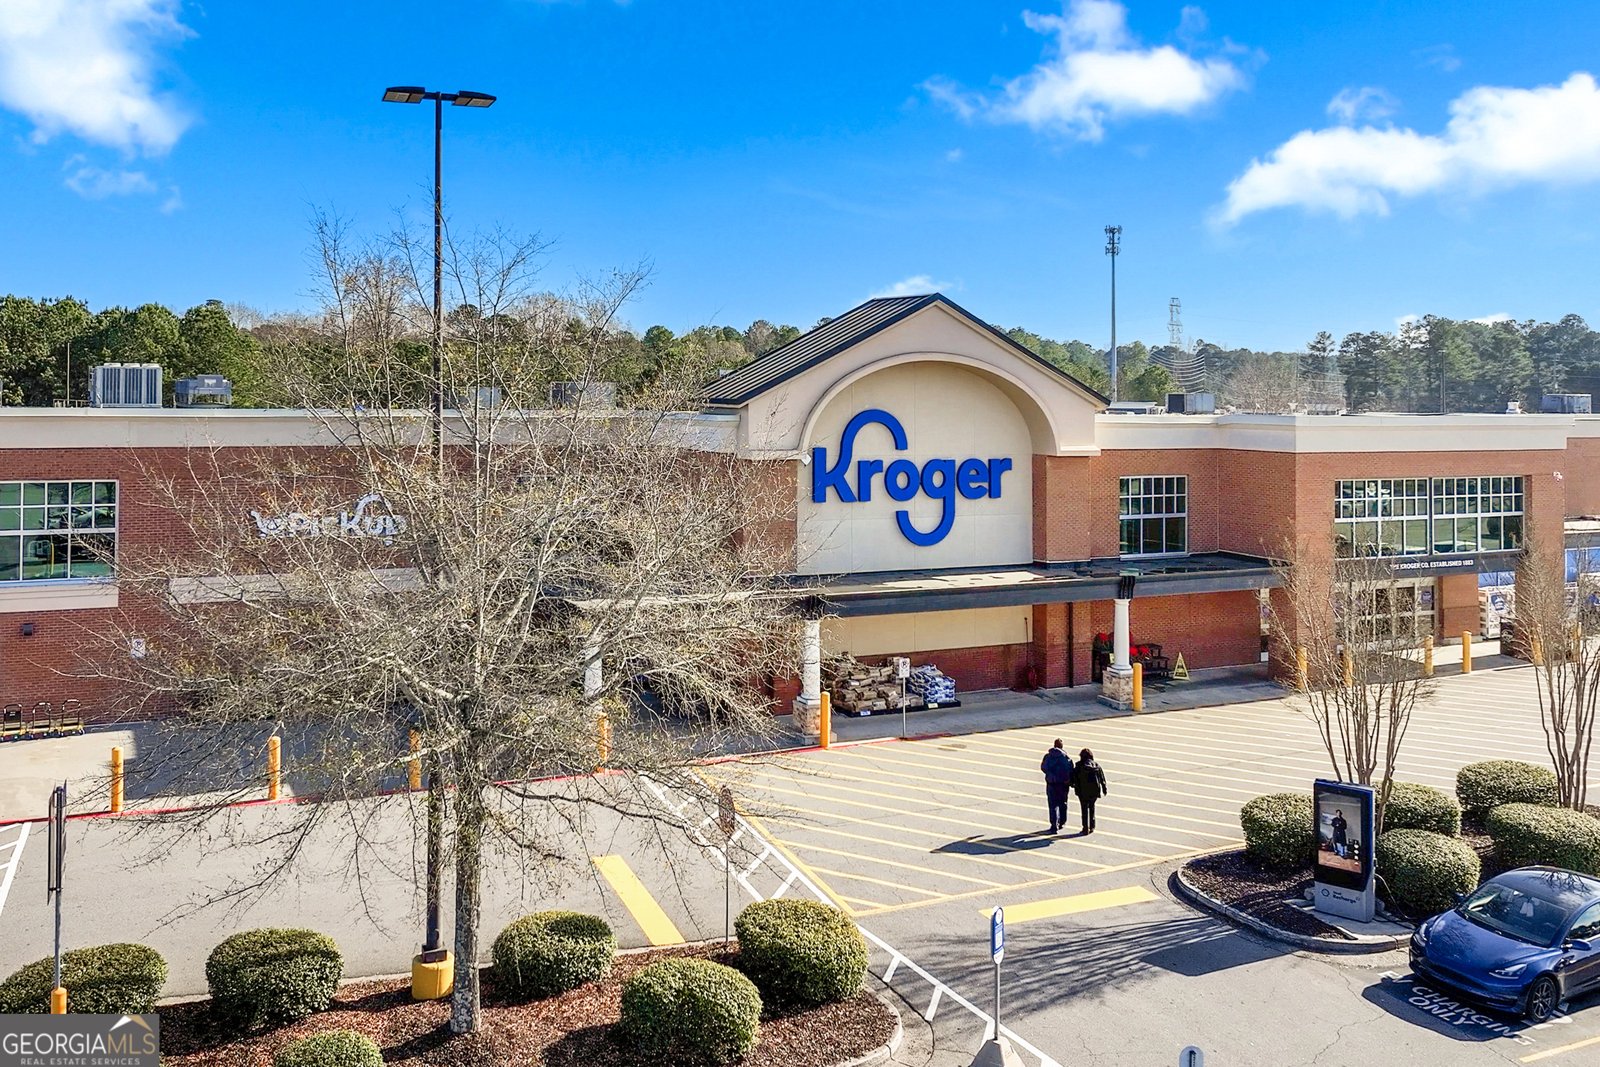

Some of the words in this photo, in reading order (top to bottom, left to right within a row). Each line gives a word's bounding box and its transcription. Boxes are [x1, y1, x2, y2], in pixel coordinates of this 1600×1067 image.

[812, 409, 1012, 546] Kroger
[1400, 562, 1420, 570] KROGER
[1430, 560, 1461, 568] ESTABLISHED
[1408, 996, 1475, 1026] ONLY
[1411, 986, 1536, 1046] CHARGING
